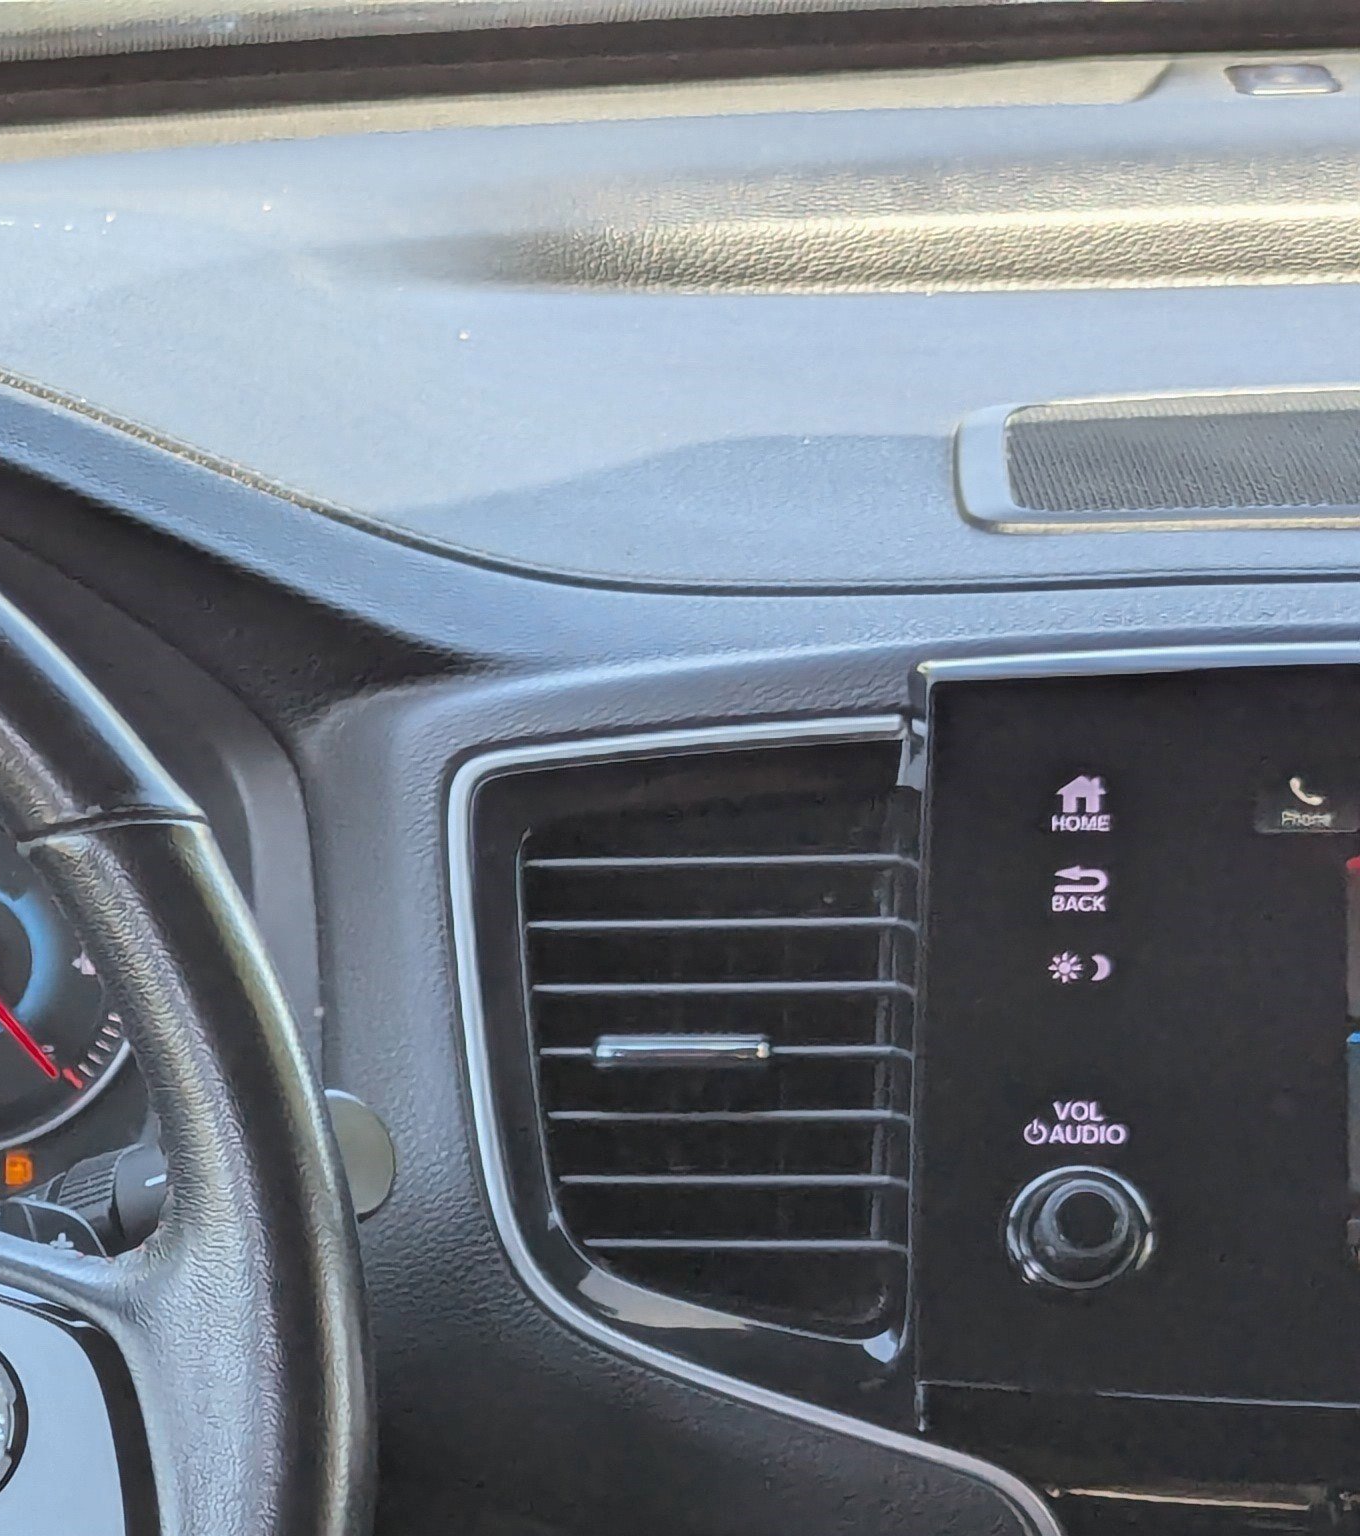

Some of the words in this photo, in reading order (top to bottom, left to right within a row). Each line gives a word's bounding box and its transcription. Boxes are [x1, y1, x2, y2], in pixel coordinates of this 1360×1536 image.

[1051, 814, 1111, 832] HOME
[1051, 894, 1107, 912] BACK
[1052, 1100, 1105, 1122] VOL
[1048, 1122, 1128, 1145] AUDIO
